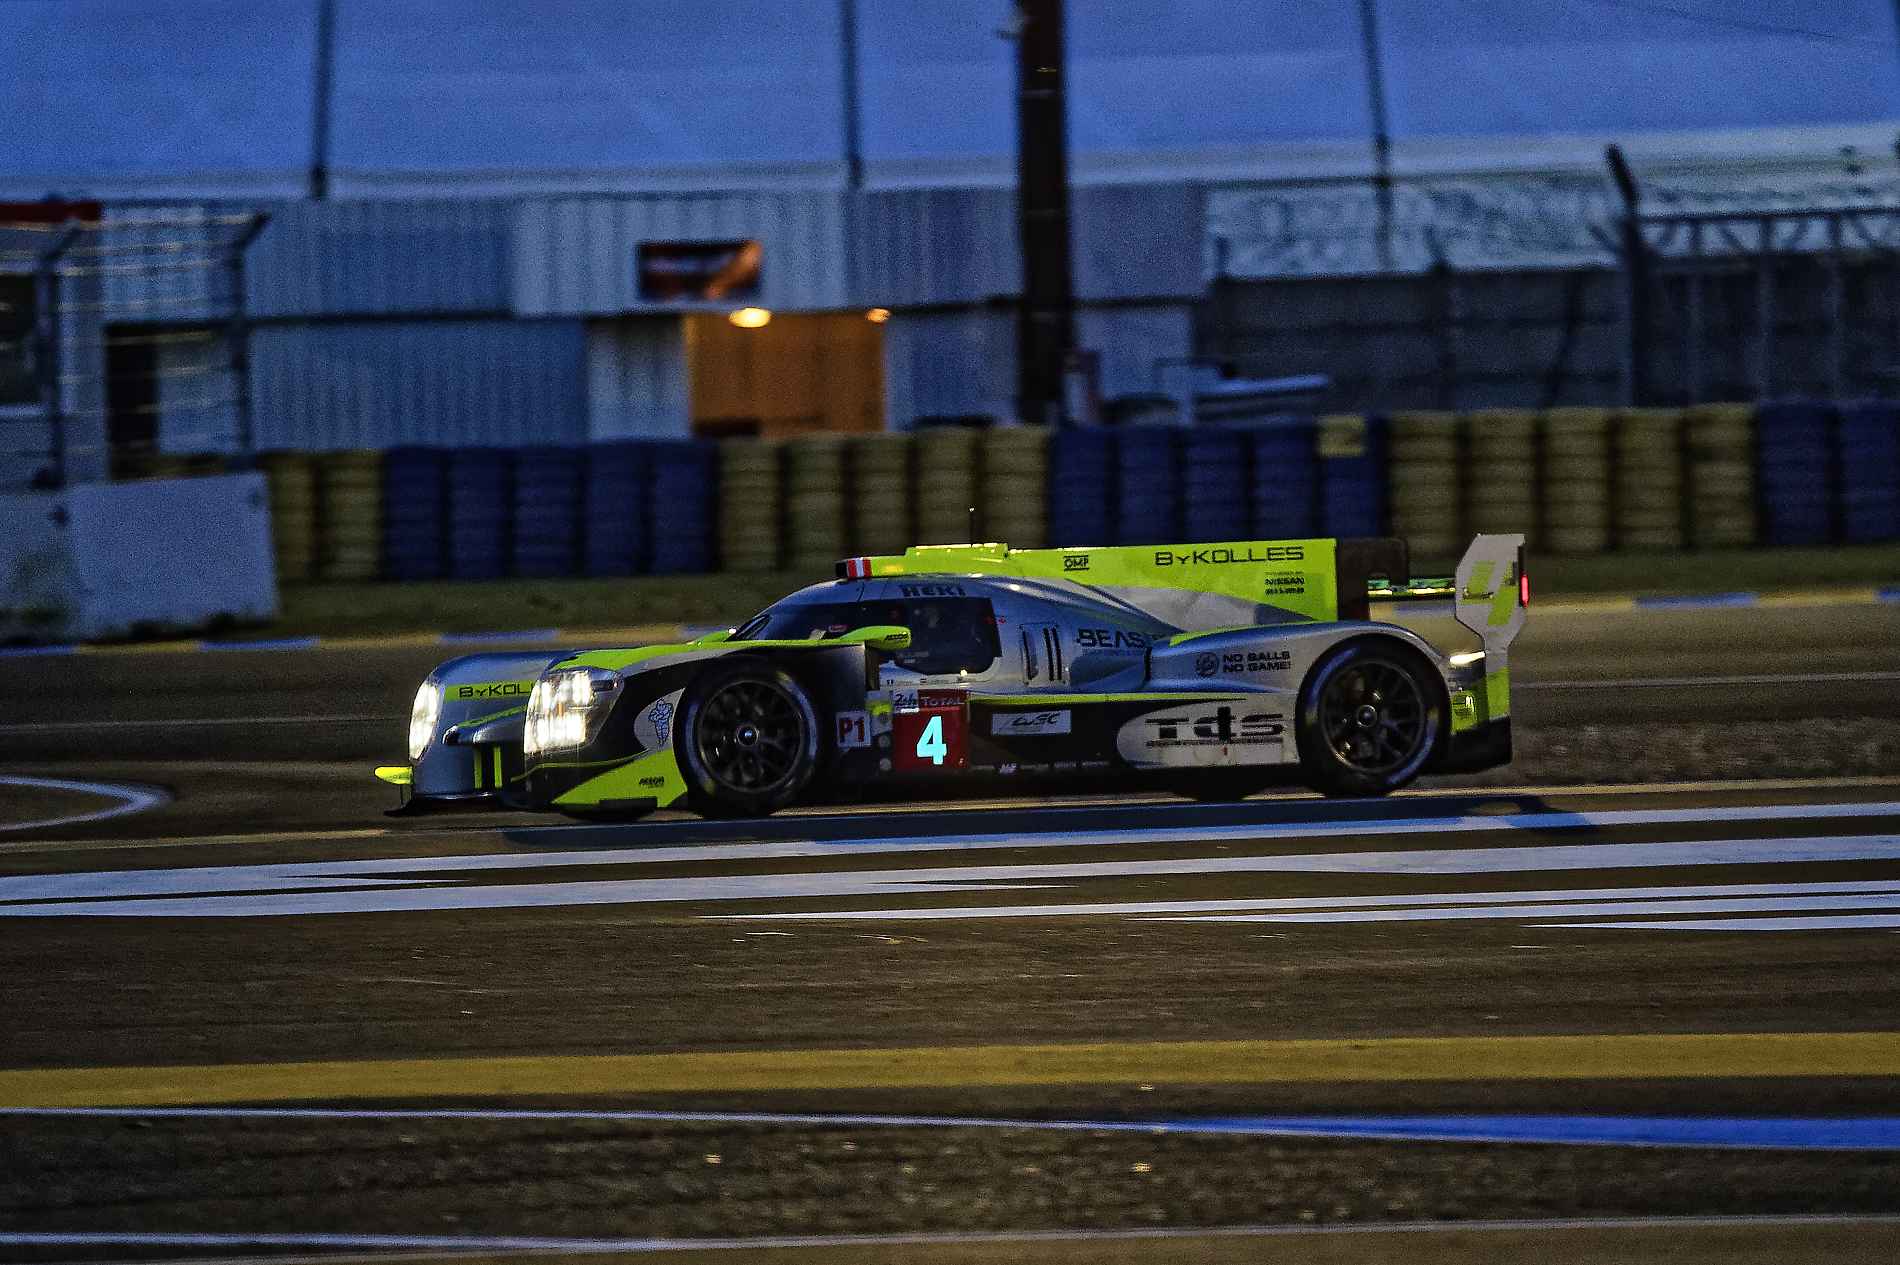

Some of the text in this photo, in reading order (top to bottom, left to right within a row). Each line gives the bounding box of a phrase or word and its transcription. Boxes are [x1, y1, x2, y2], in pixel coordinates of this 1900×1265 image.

[1223, 654, 1243, 662] NO
[1223, 663, 1244, 672] NO
[839, 717, 865, 743] P1
[917, 715, 947, 765] 4
